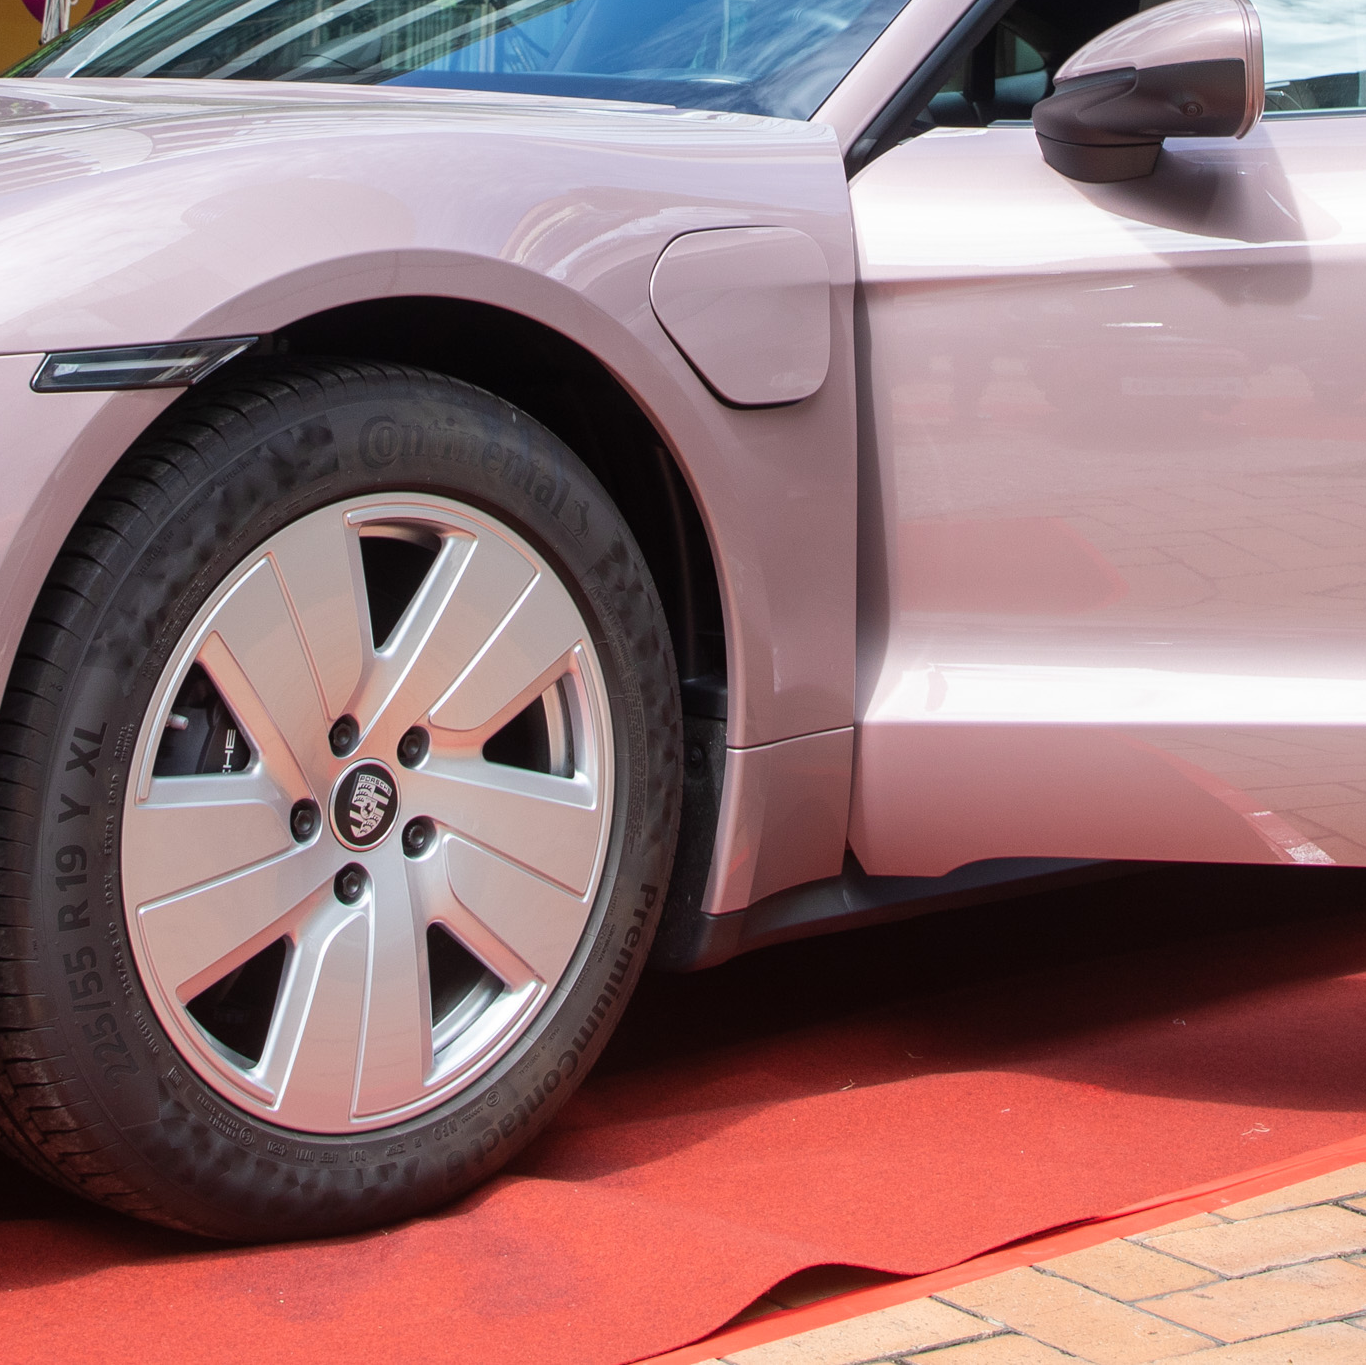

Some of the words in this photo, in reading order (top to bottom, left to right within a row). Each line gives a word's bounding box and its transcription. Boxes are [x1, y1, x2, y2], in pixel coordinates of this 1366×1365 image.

[357, 415, 572, 519] Continental
[65, 722, 108, 777] XL
[58, 793, 91, 825] Y
[63, 946, 140, 1089] 225/55
[473, 883, 659, 1155] PremiumContact
